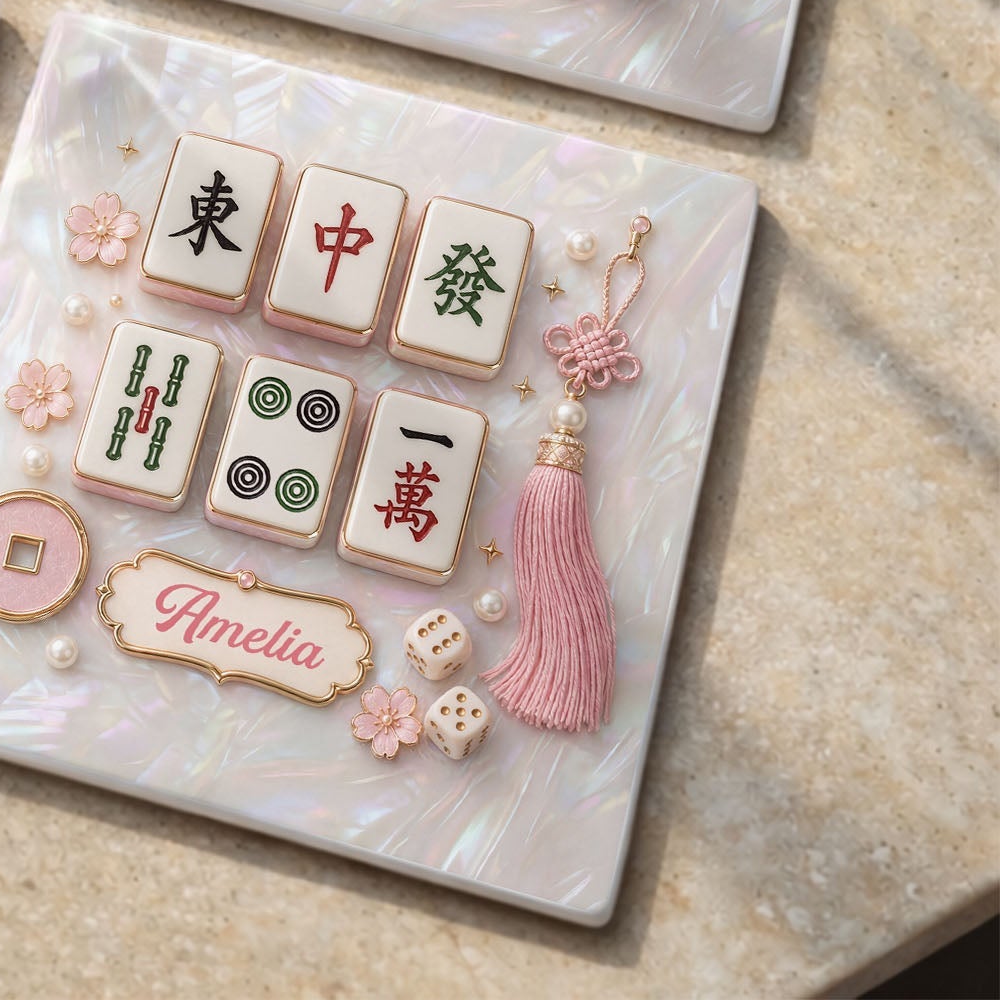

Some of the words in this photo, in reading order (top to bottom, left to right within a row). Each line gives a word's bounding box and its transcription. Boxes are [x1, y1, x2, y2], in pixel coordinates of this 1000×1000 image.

[168, 169, 243, 257] 東
[314, 202, 374, 293] 中
[423, 242, 506, 328] 發
[155, 583, 325, 670] Amelia
